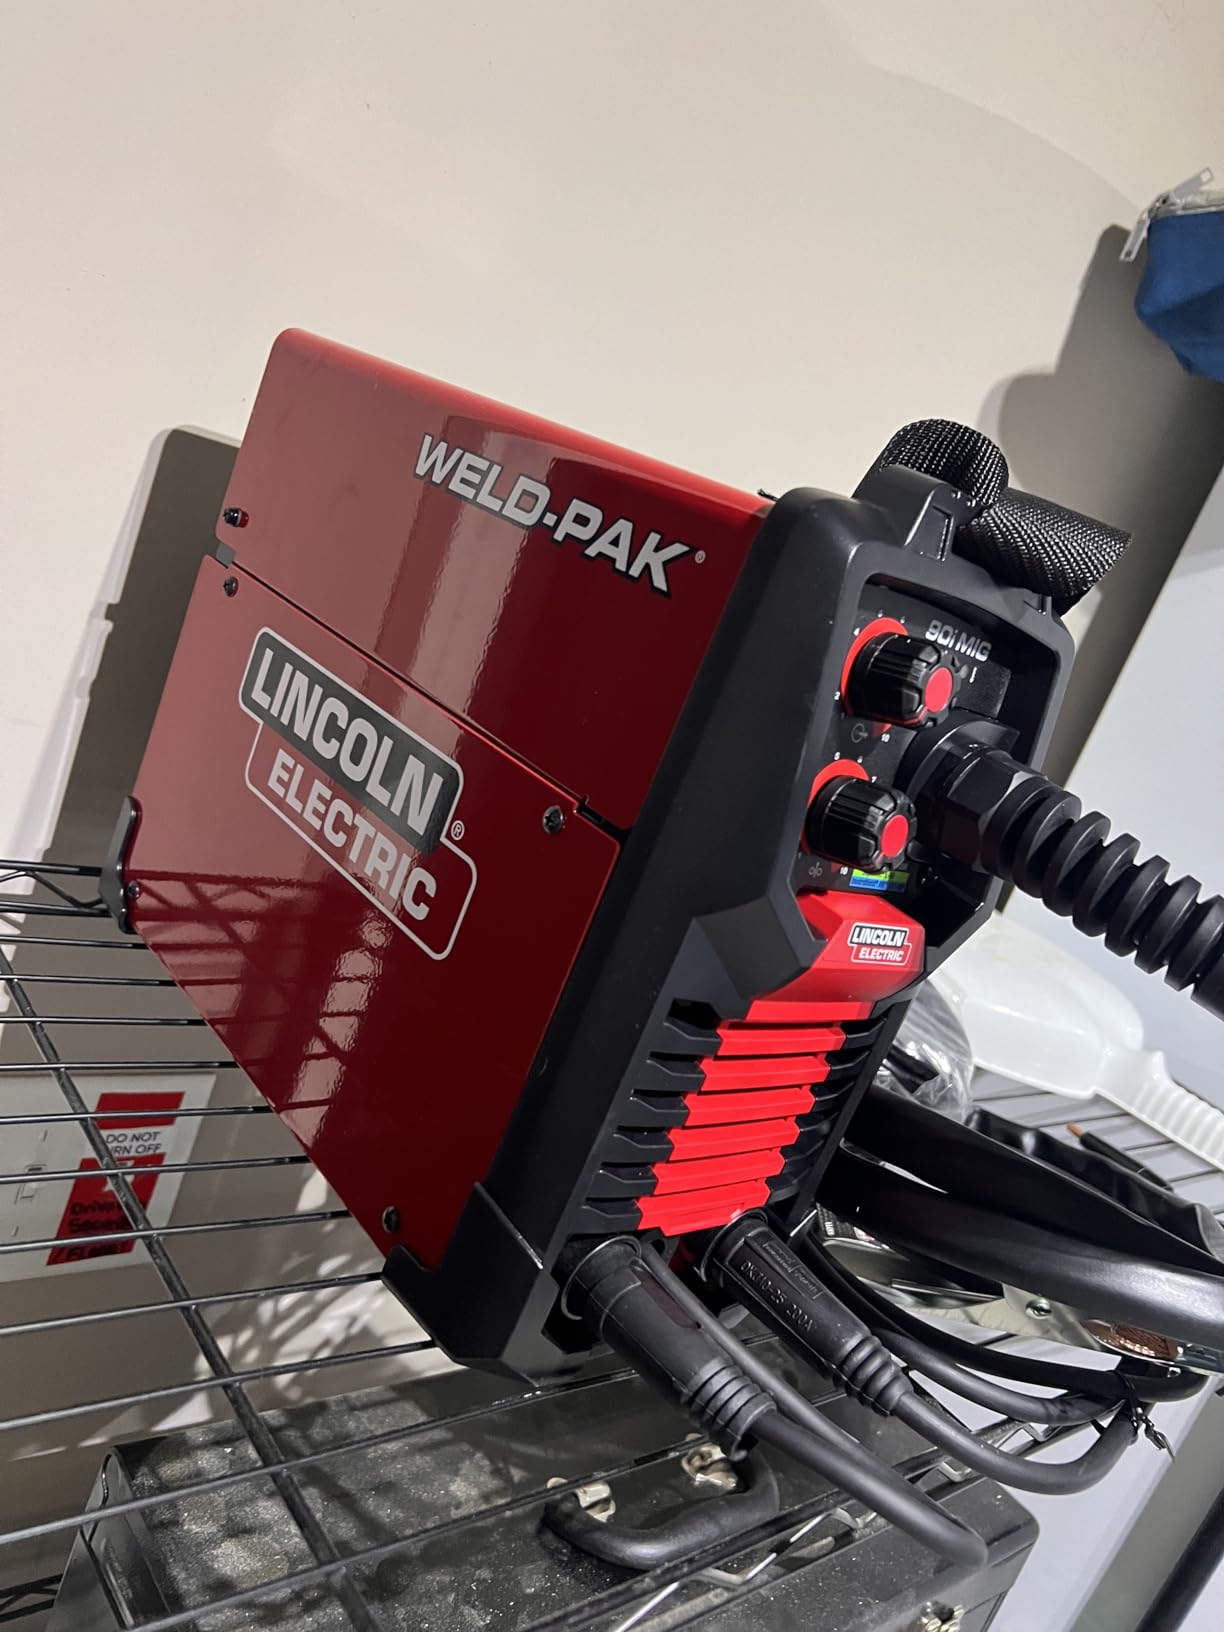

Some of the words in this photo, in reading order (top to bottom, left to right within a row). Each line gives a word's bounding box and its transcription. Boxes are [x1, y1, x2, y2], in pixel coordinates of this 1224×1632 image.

[413, 434, 691, 596] WELD-PAK
[925, 619, 957, 648] 90i
[955, 631, 992, 662] MIG
[249, 646, 446, 837] LINCOLN
[881, 732, 891, 743] 10
[266, 747, 438, 921] ELECTRIC
[852, 927, 905, 947] LINCOLN
[858, 946, 905, 962] ELECTRIC
[106, 1133, 128, 1144] DO
[130, 1131, 161, 1143] NOT
[135, 1143, 162, 1154] OFF
